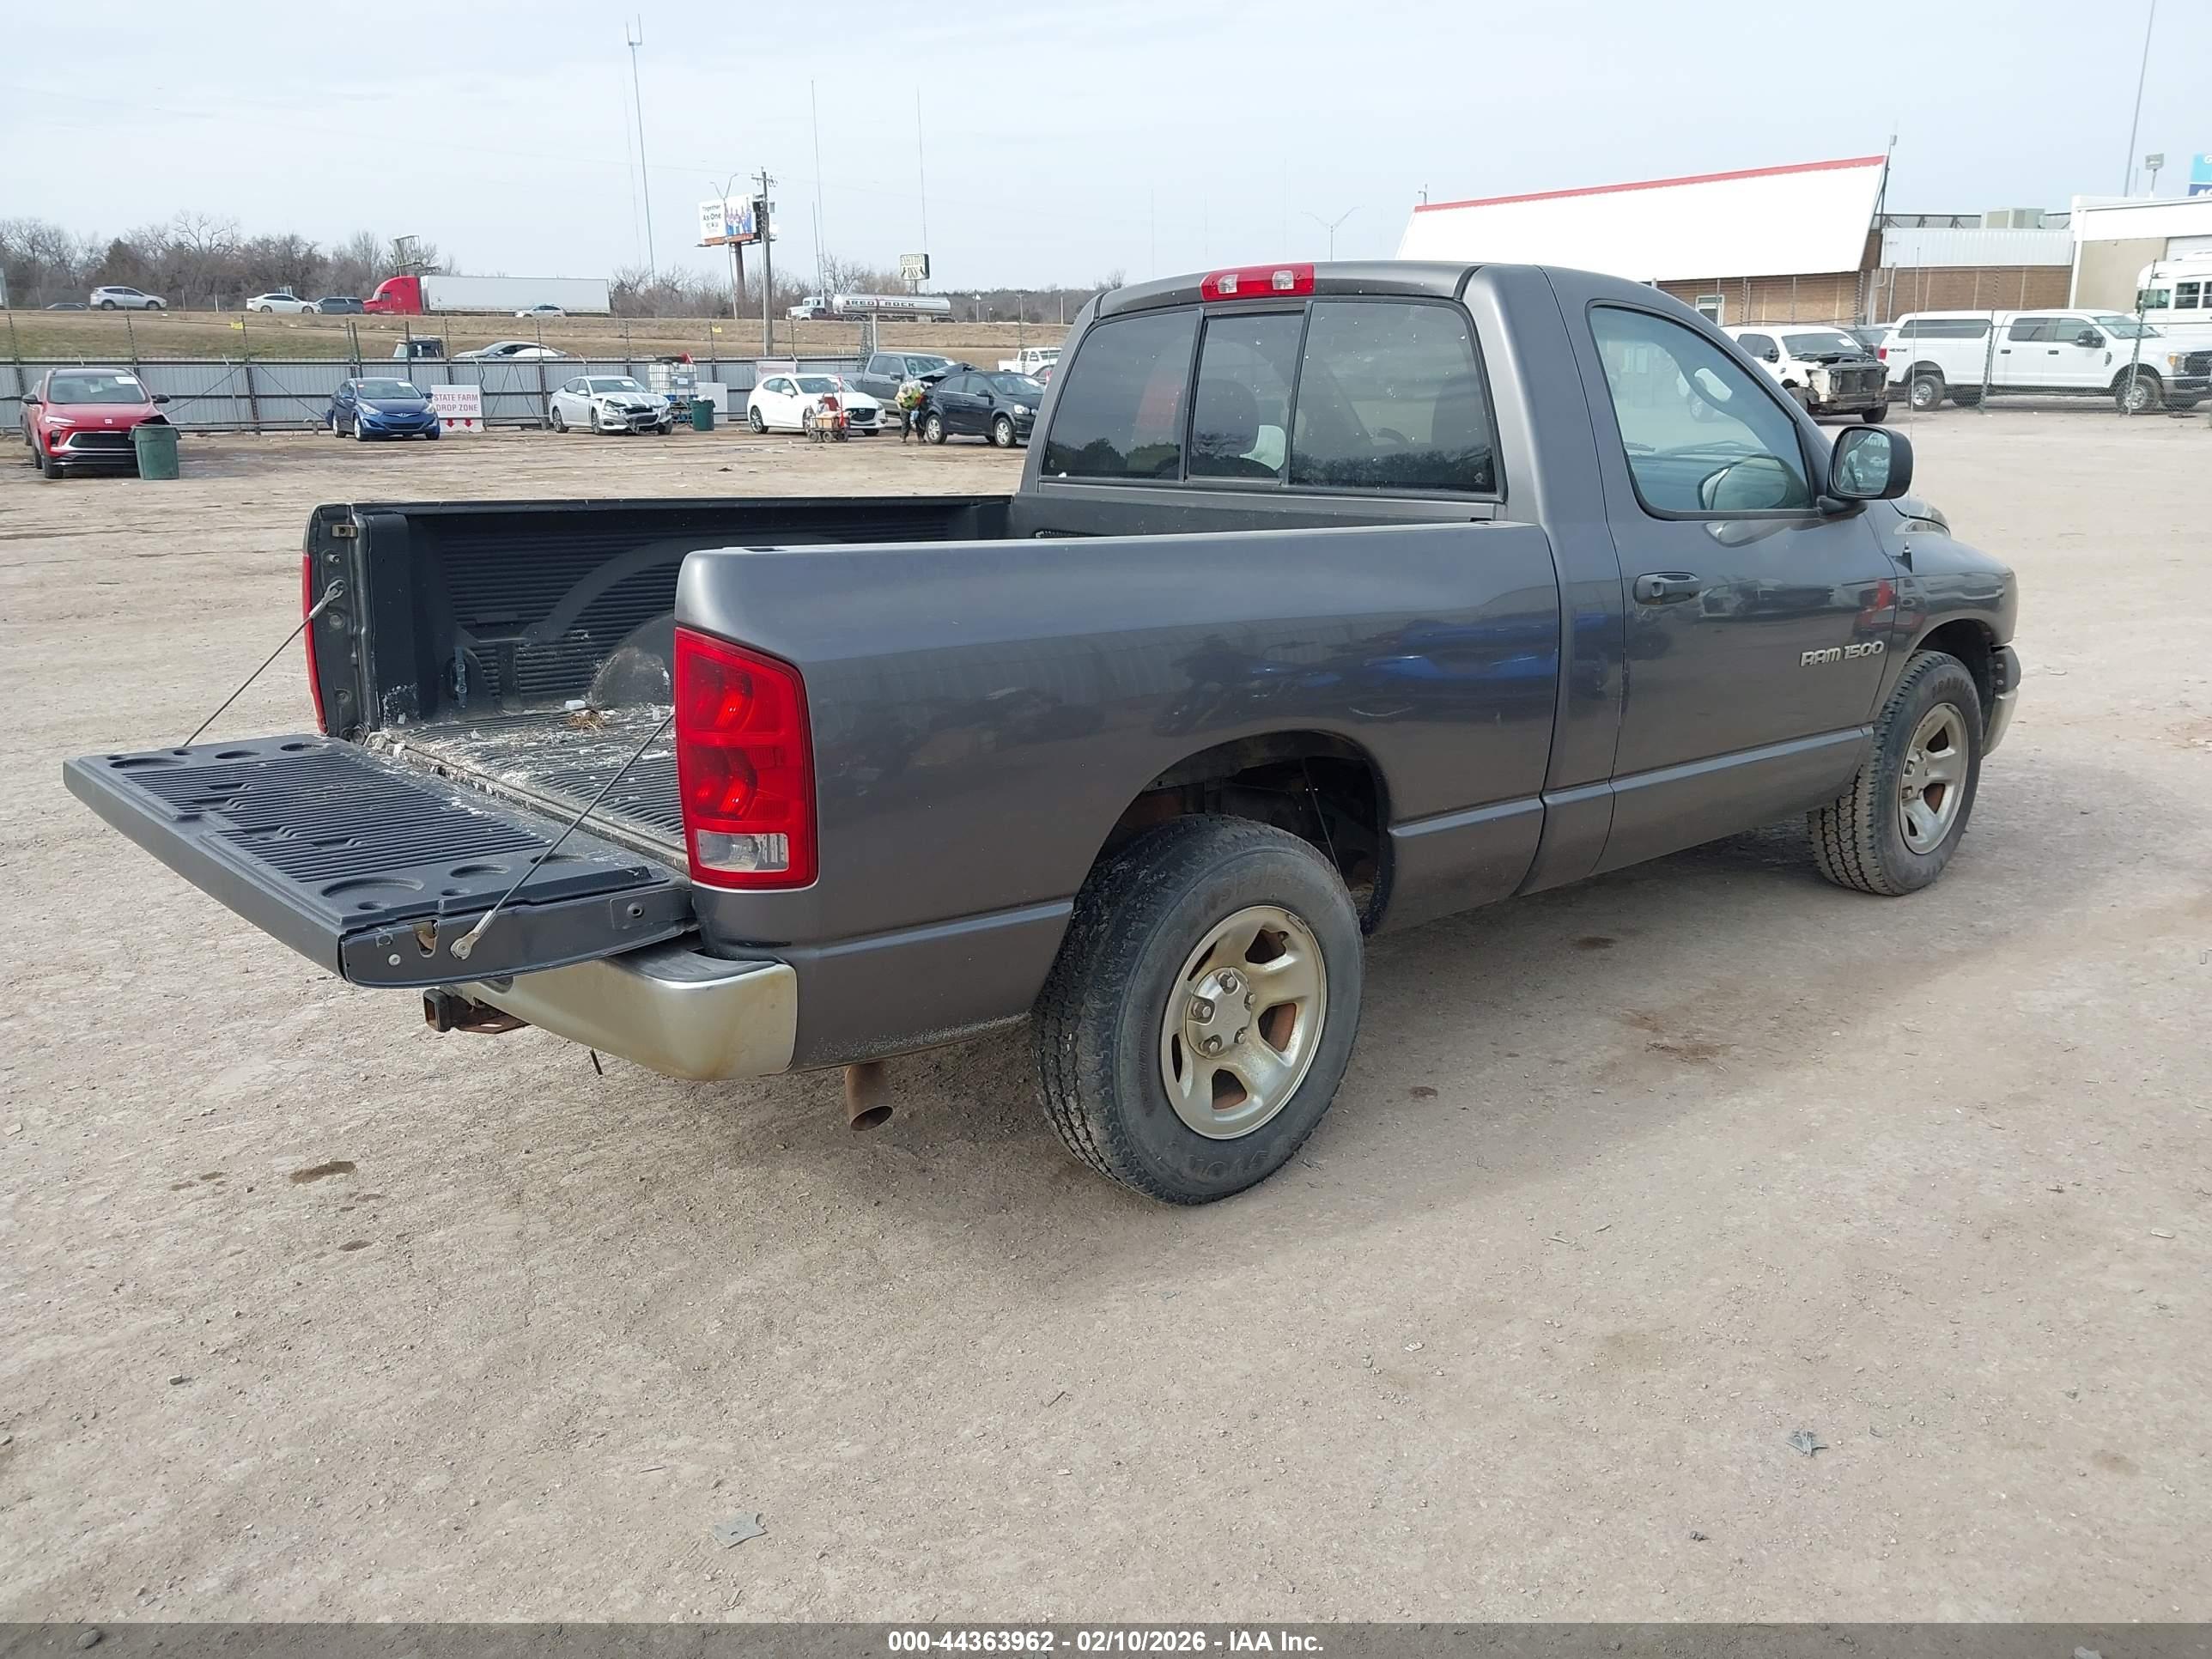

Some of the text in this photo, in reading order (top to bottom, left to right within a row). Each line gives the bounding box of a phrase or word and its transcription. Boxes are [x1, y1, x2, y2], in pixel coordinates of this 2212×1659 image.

[710, 212, 721, 221] One
[435, 404, 478, 412] DROP ZONE
[1800, 640, 1885, 667] RAM 1500
